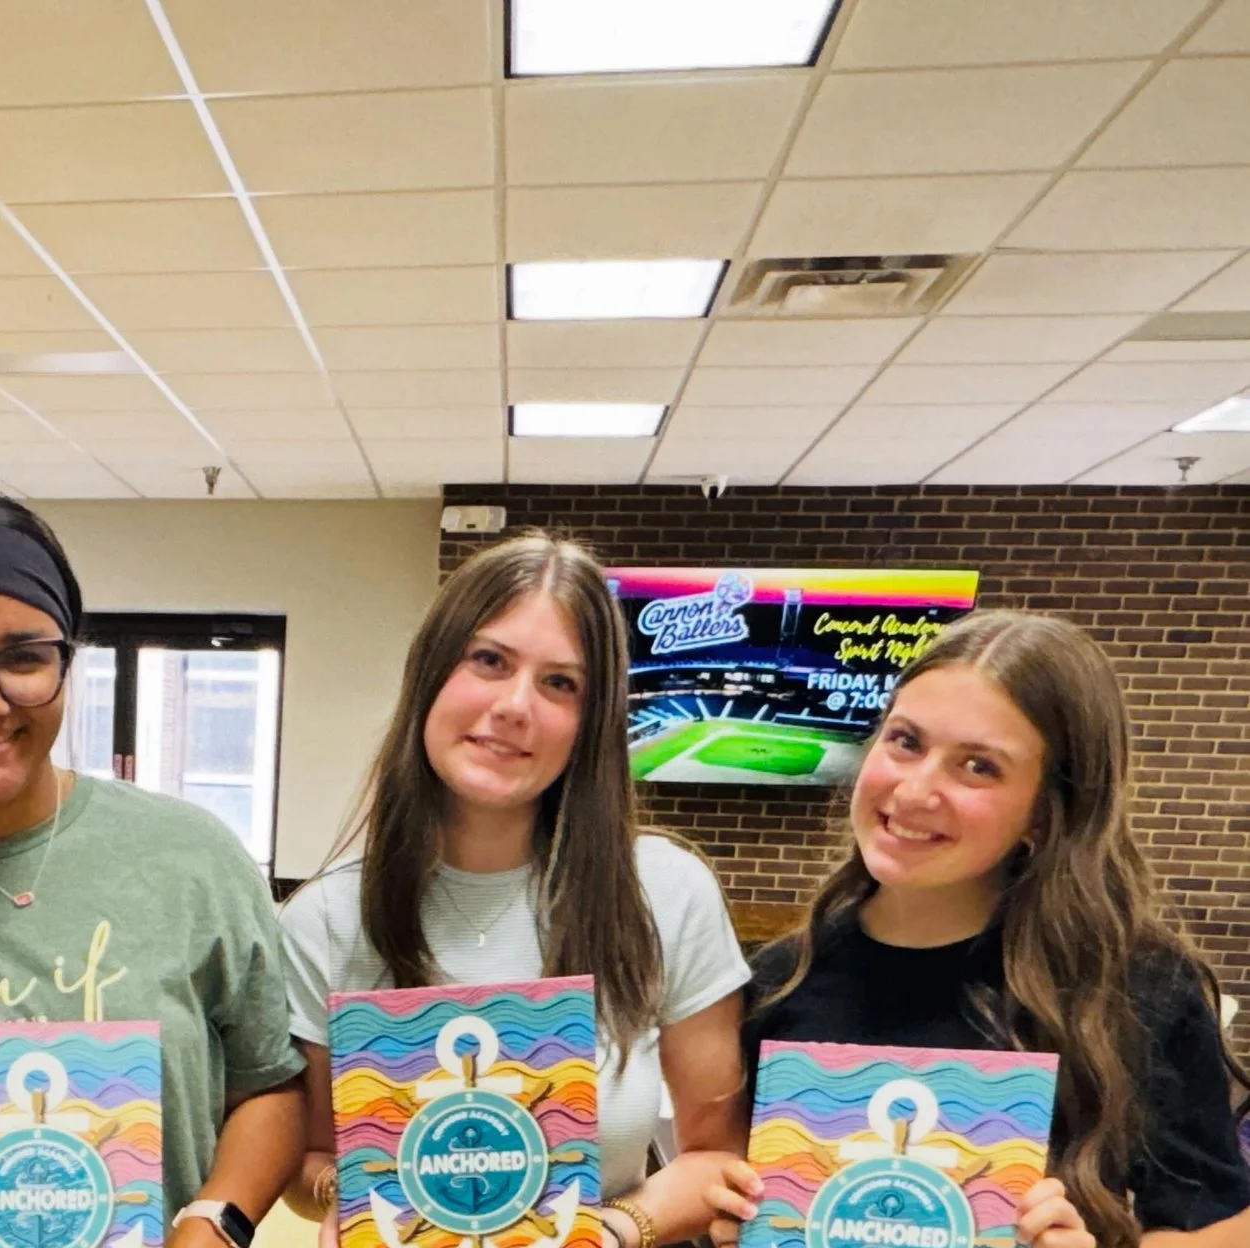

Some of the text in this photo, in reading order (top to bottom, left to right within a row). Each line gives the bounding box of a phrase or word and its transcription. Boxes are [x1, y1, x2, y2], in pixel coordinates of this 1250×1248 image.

[642, 600, 714, 631] Cannon
[654, 618, 743, 651] Ballers
[806, 673, 880, 692] FRIDAY,
[825, 691, 847, 711] @
[53, 920, 129, 1023] if
[419, 1150, 526, 1175] ANCHORED
[828, 1218, 949, 1248] ANCHORED
